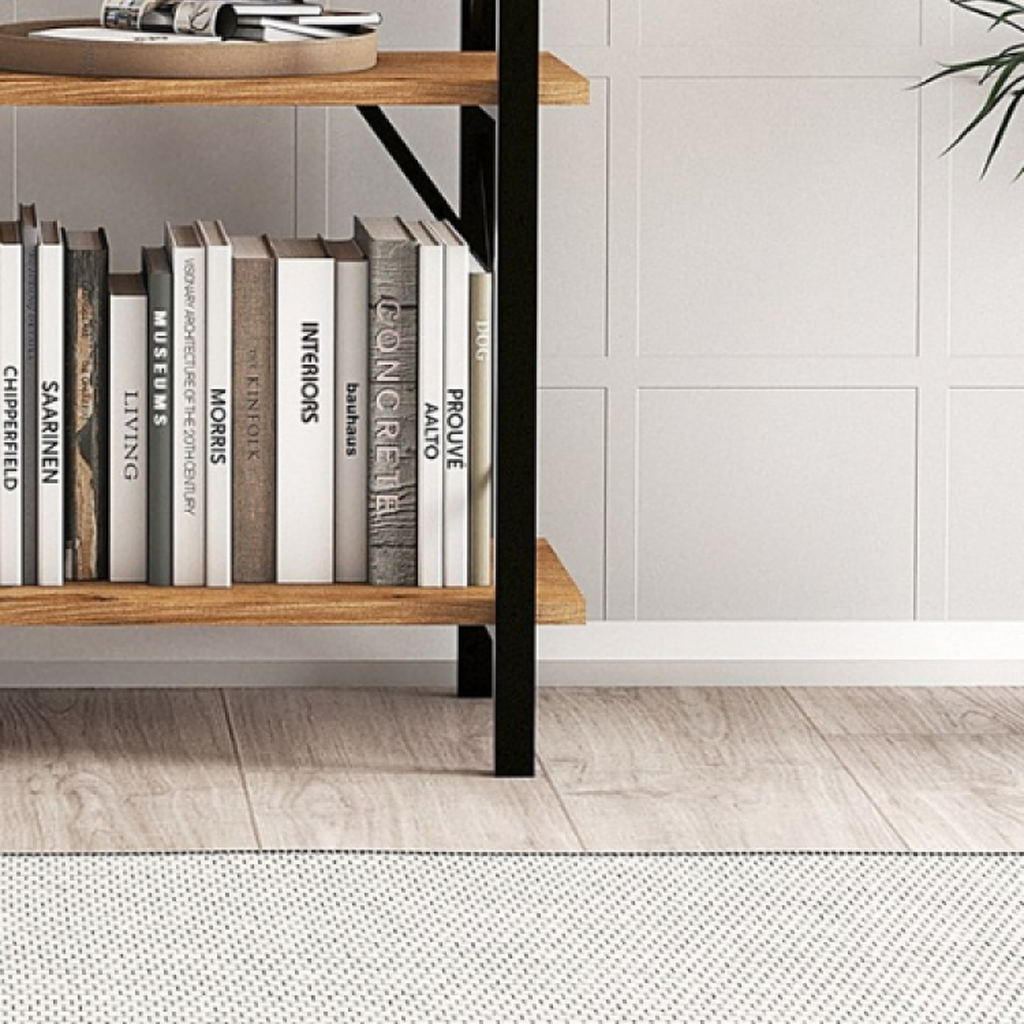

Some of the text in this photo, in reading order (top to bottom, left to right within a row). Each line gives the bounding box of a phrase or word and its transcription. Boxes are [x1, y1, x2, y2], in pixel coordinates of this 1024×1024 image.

[153, 310, 168, 426] MUSEUMS
[183, 257, 196, 517] VISIONARY ARCHITECTURE OF THE 20TH CENTURY
[300, 322, 320, 424] INTERIORS
[475, 319, 489, 362] DOG
[3, 365, 18, 491] CHIPPERFIELD
[41, 380, 59, 484] SAARINEN
[124, 390, 139, 481] LIVING
[210, 388, 226, 465] MORRIS
[246, 376, 261, 461] KINFOLK
[346, 382, 360, 456] bauhaus
[375, 296, 401, 514] CONCRETE
[423, 402, 439, 460] AALTO
